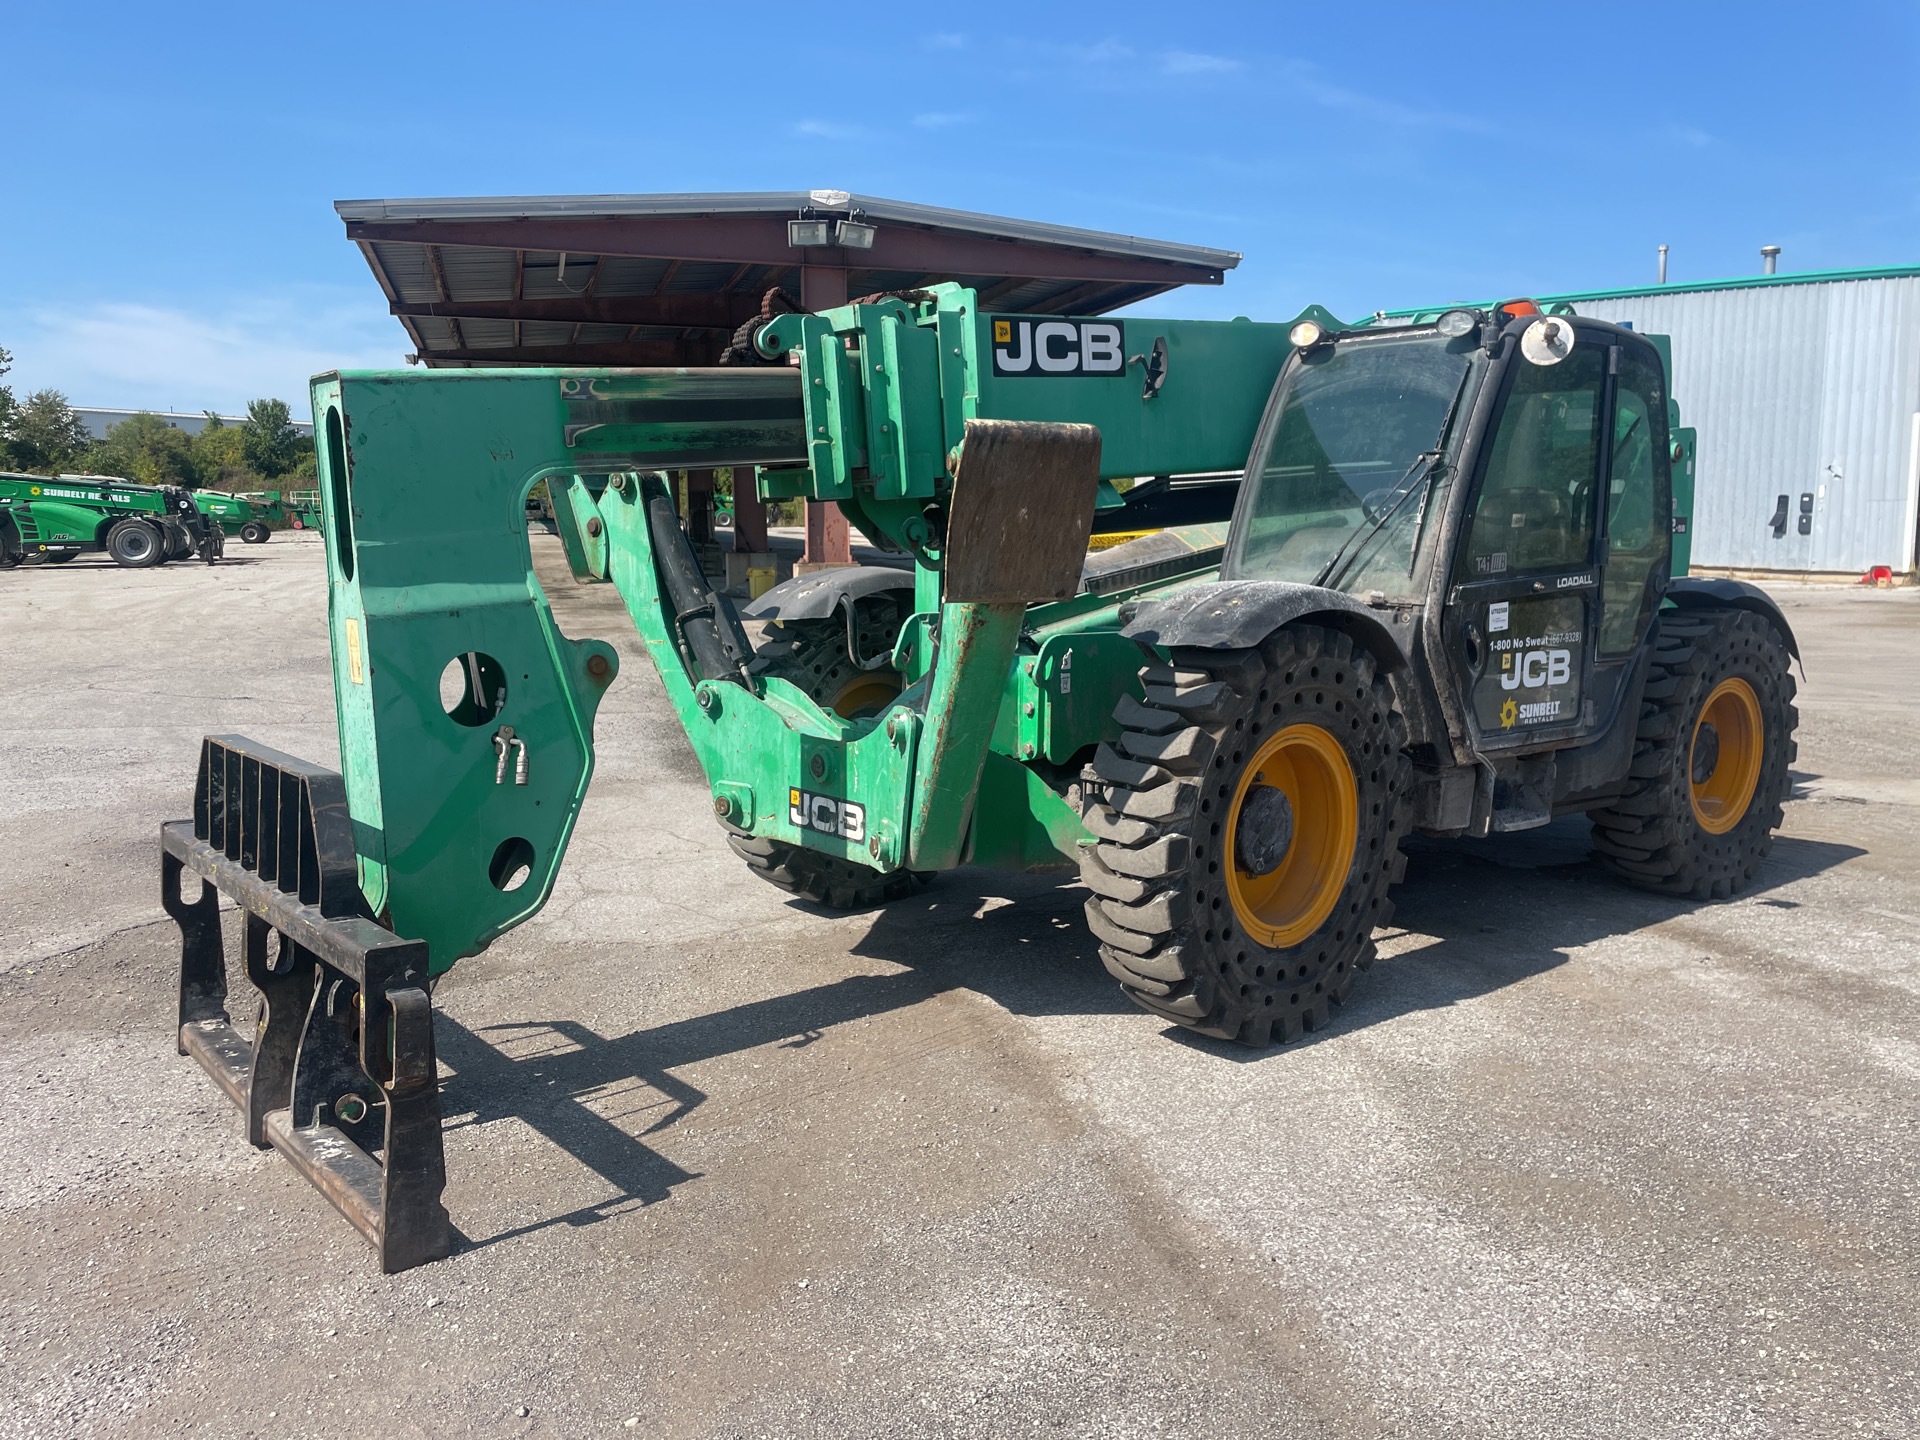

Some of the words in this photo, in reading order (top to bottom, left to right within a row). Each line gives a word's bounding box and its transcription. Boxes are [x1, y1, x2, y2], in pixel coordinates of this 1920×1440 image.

[995, 321, 1123, 372] JCB
[43, 488, 86, 499] SUNBELT
[87, 491, 130, 503] REALS
[1557, 574, 1593, 589] LOADALL
[1489, 639, 1511, 652] 1-800
[1513, 637, 1524, 649] No
[1525, 635, 1549, 648] Sweat
[1549, 631, 1582, 645] (667-9328)
[1501, 649, 1571, 690] JCB
[1519, 700, 1560, 719] SUNBELT
[1524, 715, 1554, 725] RENTALS
[790, 792, 864, 841] JCB
